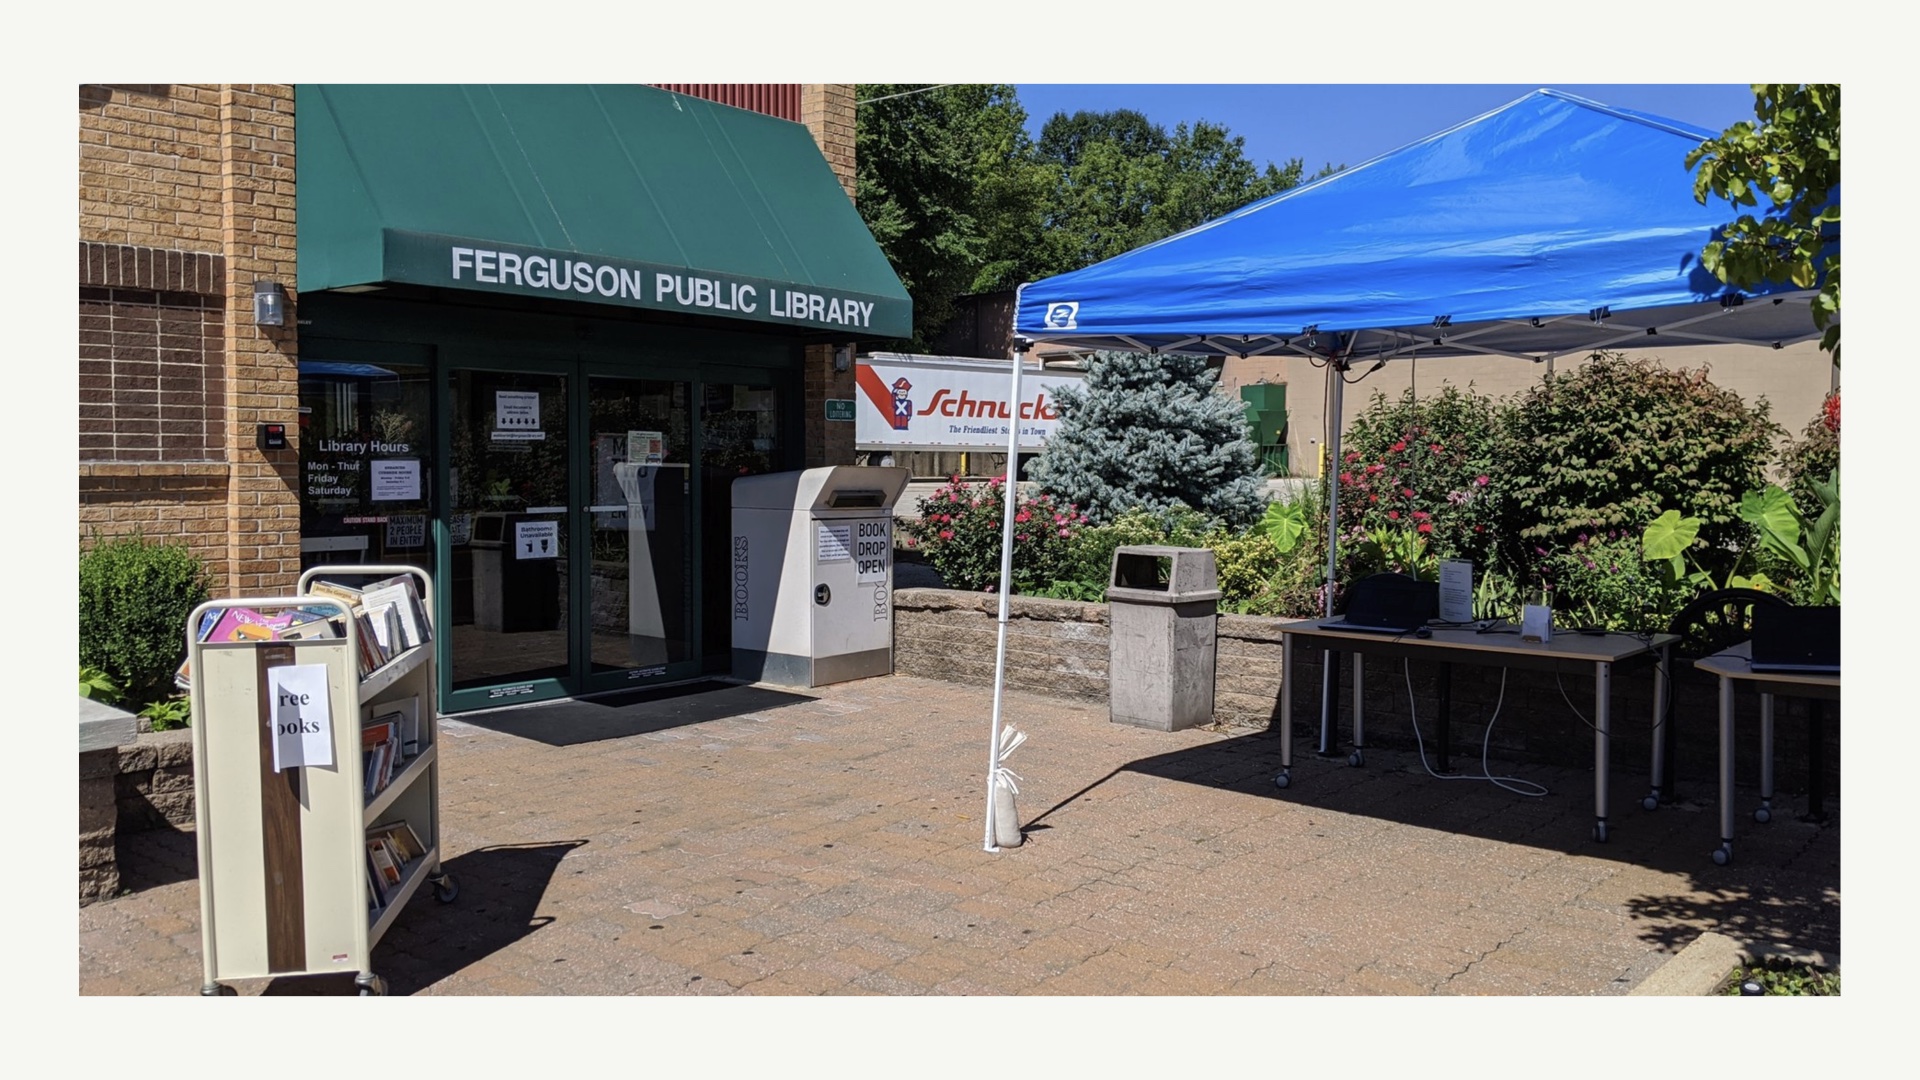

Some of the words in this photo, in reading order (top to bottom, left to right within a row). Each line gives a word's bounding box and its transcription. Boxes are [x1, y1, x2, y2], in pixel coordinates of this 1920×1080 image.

[452, 246, 641, 300] FERGUSON
[656, 273, 757, 314] PUBLIC
[769, 289, 874, 328] LIBRARY
[836, 402, 846, 410] NO
[917, 389, 1057, 421] Schnuck
[830, 410, 852, 418] LOITERING
[949, 425, 961, 434] The
[963, 426, 998, 434] Friendliest
[1022, 427, 1029, 435] in
[1030, 427, 1046, 435] Town
[319, 439, 366, 455] Library
[370, 440, 409, 452] Hours
[308, 462, 329, 471] Mon
[308, 474, 338, 485] Friday
[308, 486, 351, 497] Saturday
[362, 516, 376, 524] STAND
[389, 515, 423, 525] MAXIMUM
[390, 526, 395, 536] 2
[396, 526, 422, 535] PEOPLE
[520, 531, 554, 539] Unavailable
[859, 523, 886, 538] BOOK
[390, 536, 398, 546] IN
[399, 536, 421, 546] ENTRY
[858, 541, 886, 556] DROP
[858, 559, 885, 574] OPEN
[734, 536, 749, 621] BOOKS
[231, 610, 255, 624] NEW
[279, 693, 310, 707] ree
[278, 717, 320, 736] ooks
